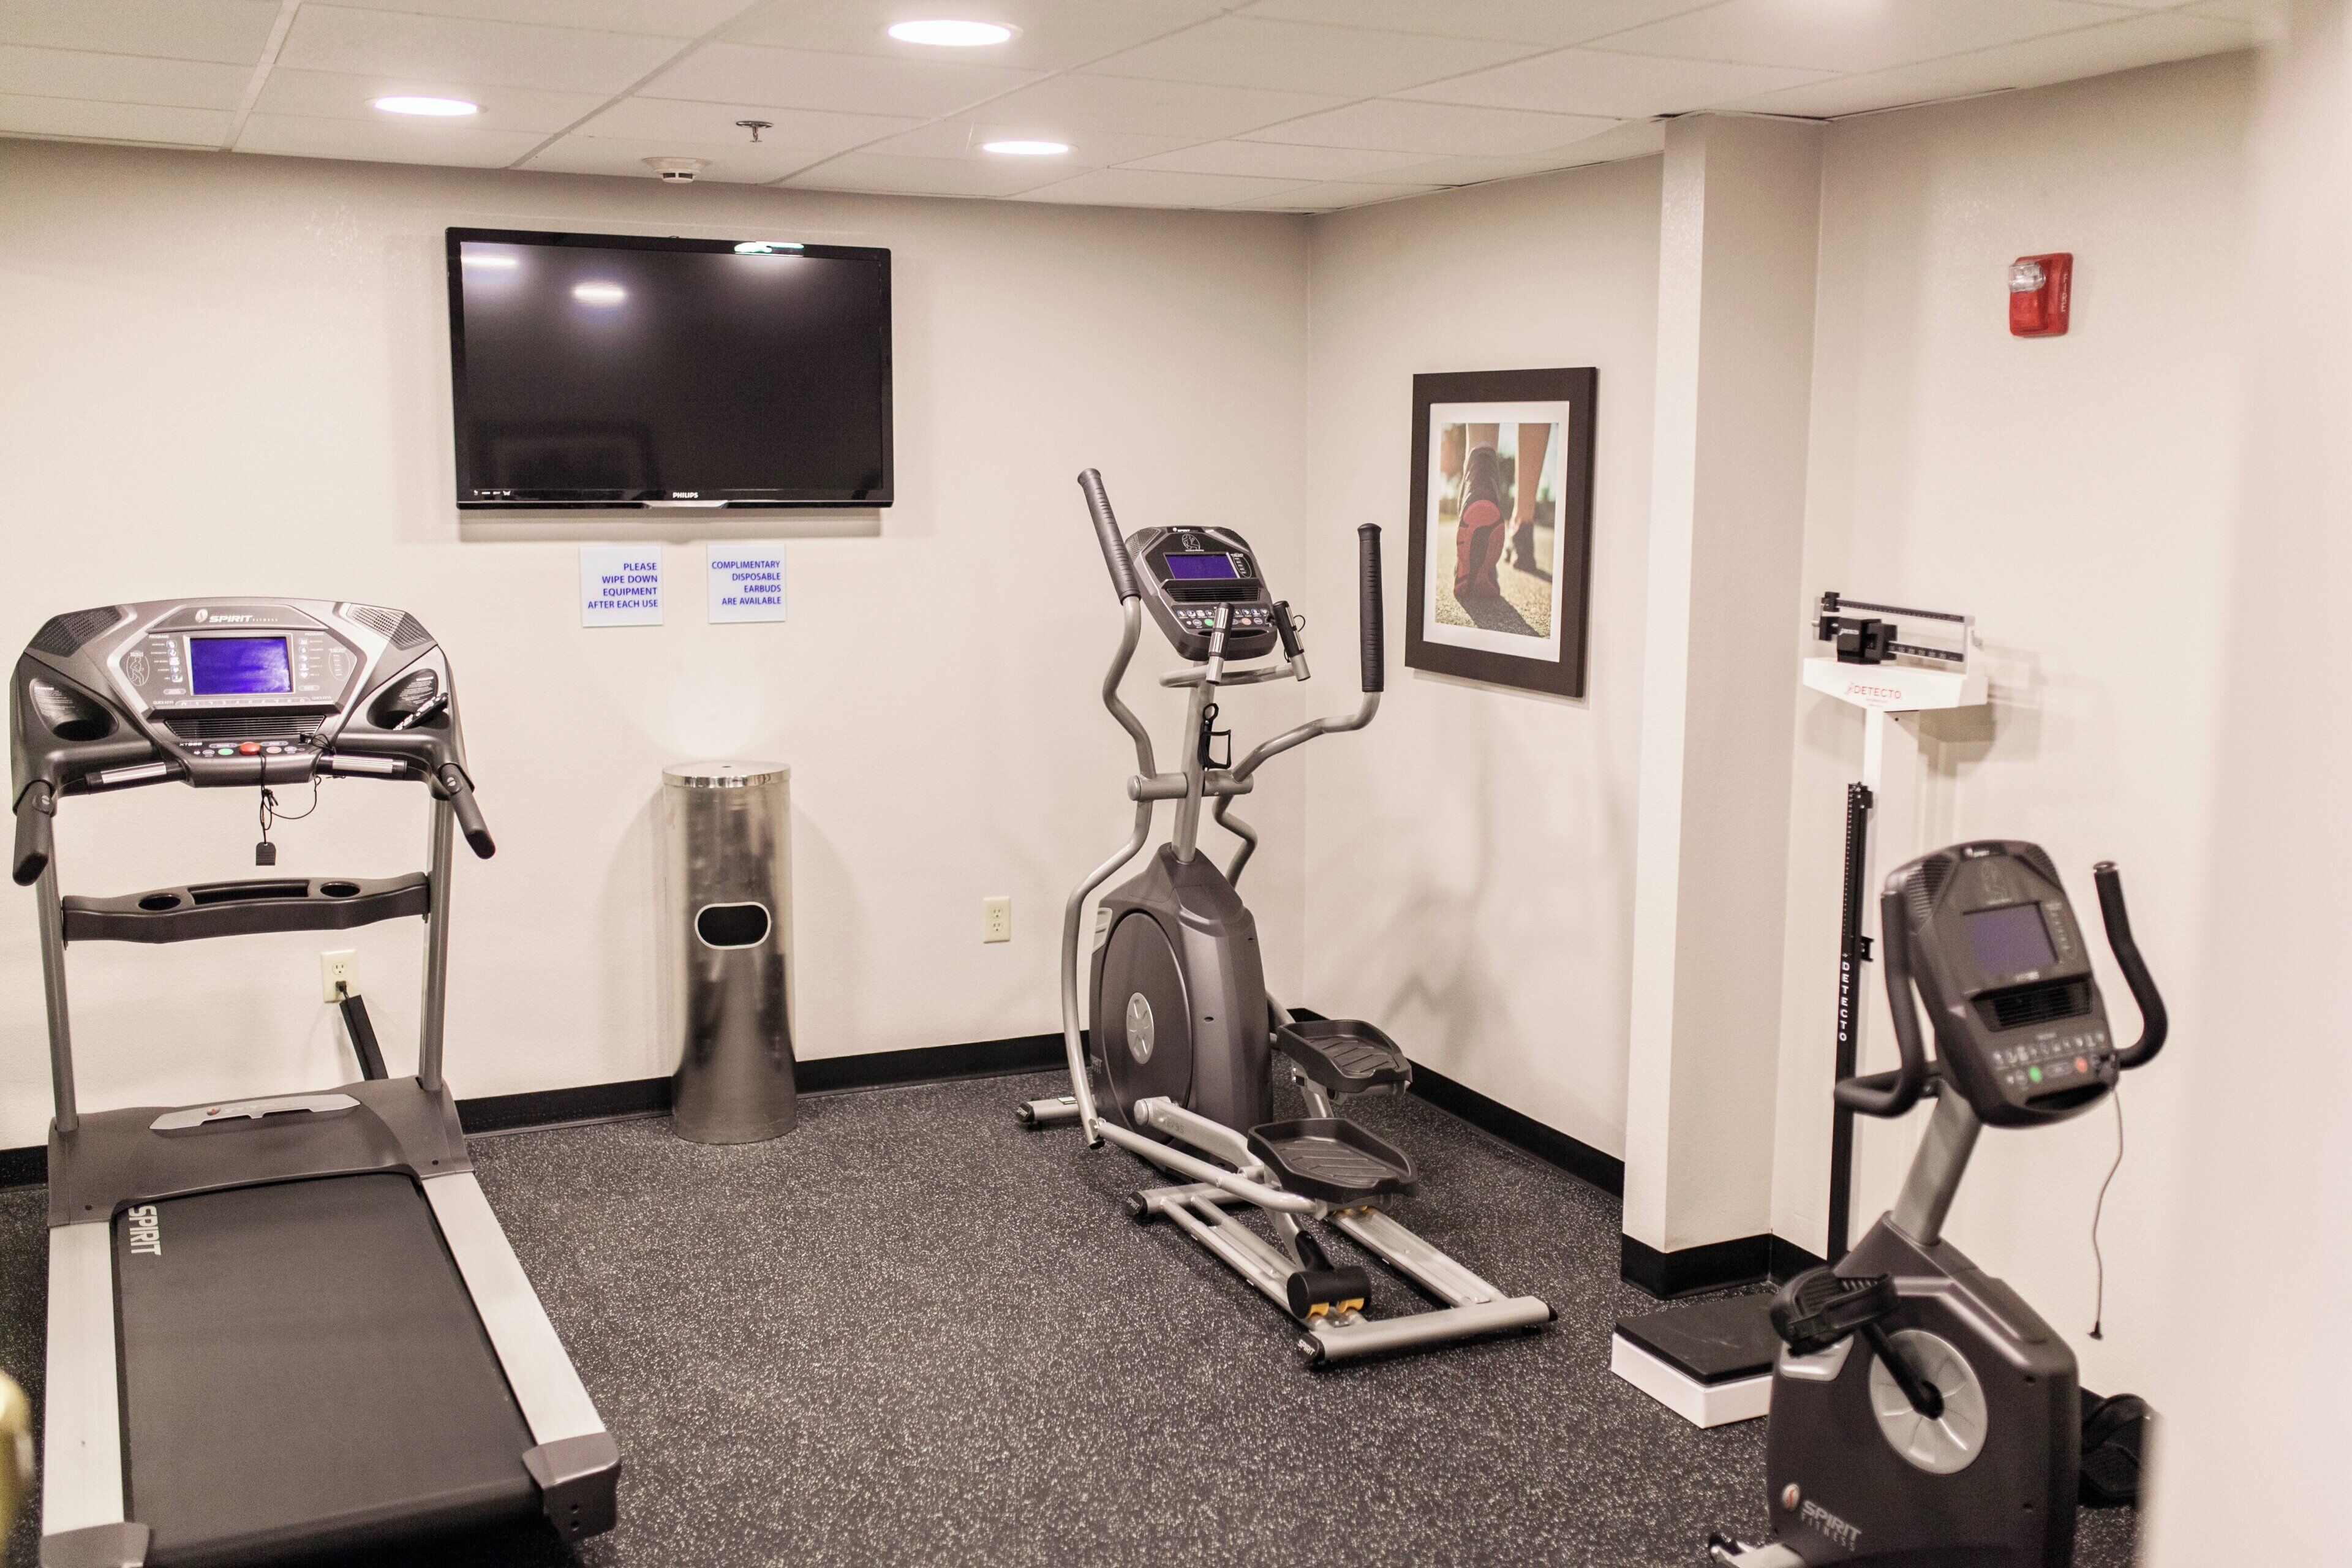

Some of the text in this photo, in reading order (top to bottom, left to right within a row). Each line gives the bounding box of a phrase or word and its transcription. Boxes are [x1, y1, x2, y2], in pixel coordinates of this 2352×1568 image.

[712, 560, 780, 569] COMPLIMENTARY
[603, 587, 657, 597] EQUIPMENT
[744, 584, 781, 593] EARBUDS
[588, 600, 614, 609] AFTER
[617, 600, 639, 608] EACH
[739, 597, 781, 605] AVAILABLE
[1854, 685, 1901, 699] DETECTO
[1839, 961, 1850, 1041] DETECTO
[128, 1205, 162, 1256] SPIRIT
[1297, 1339, 1316, 1355] SPIRIT
[1802, 1500, 1863, 1543] SPIRIT
[1801, 1512, 1855, 1551] FITNESS
